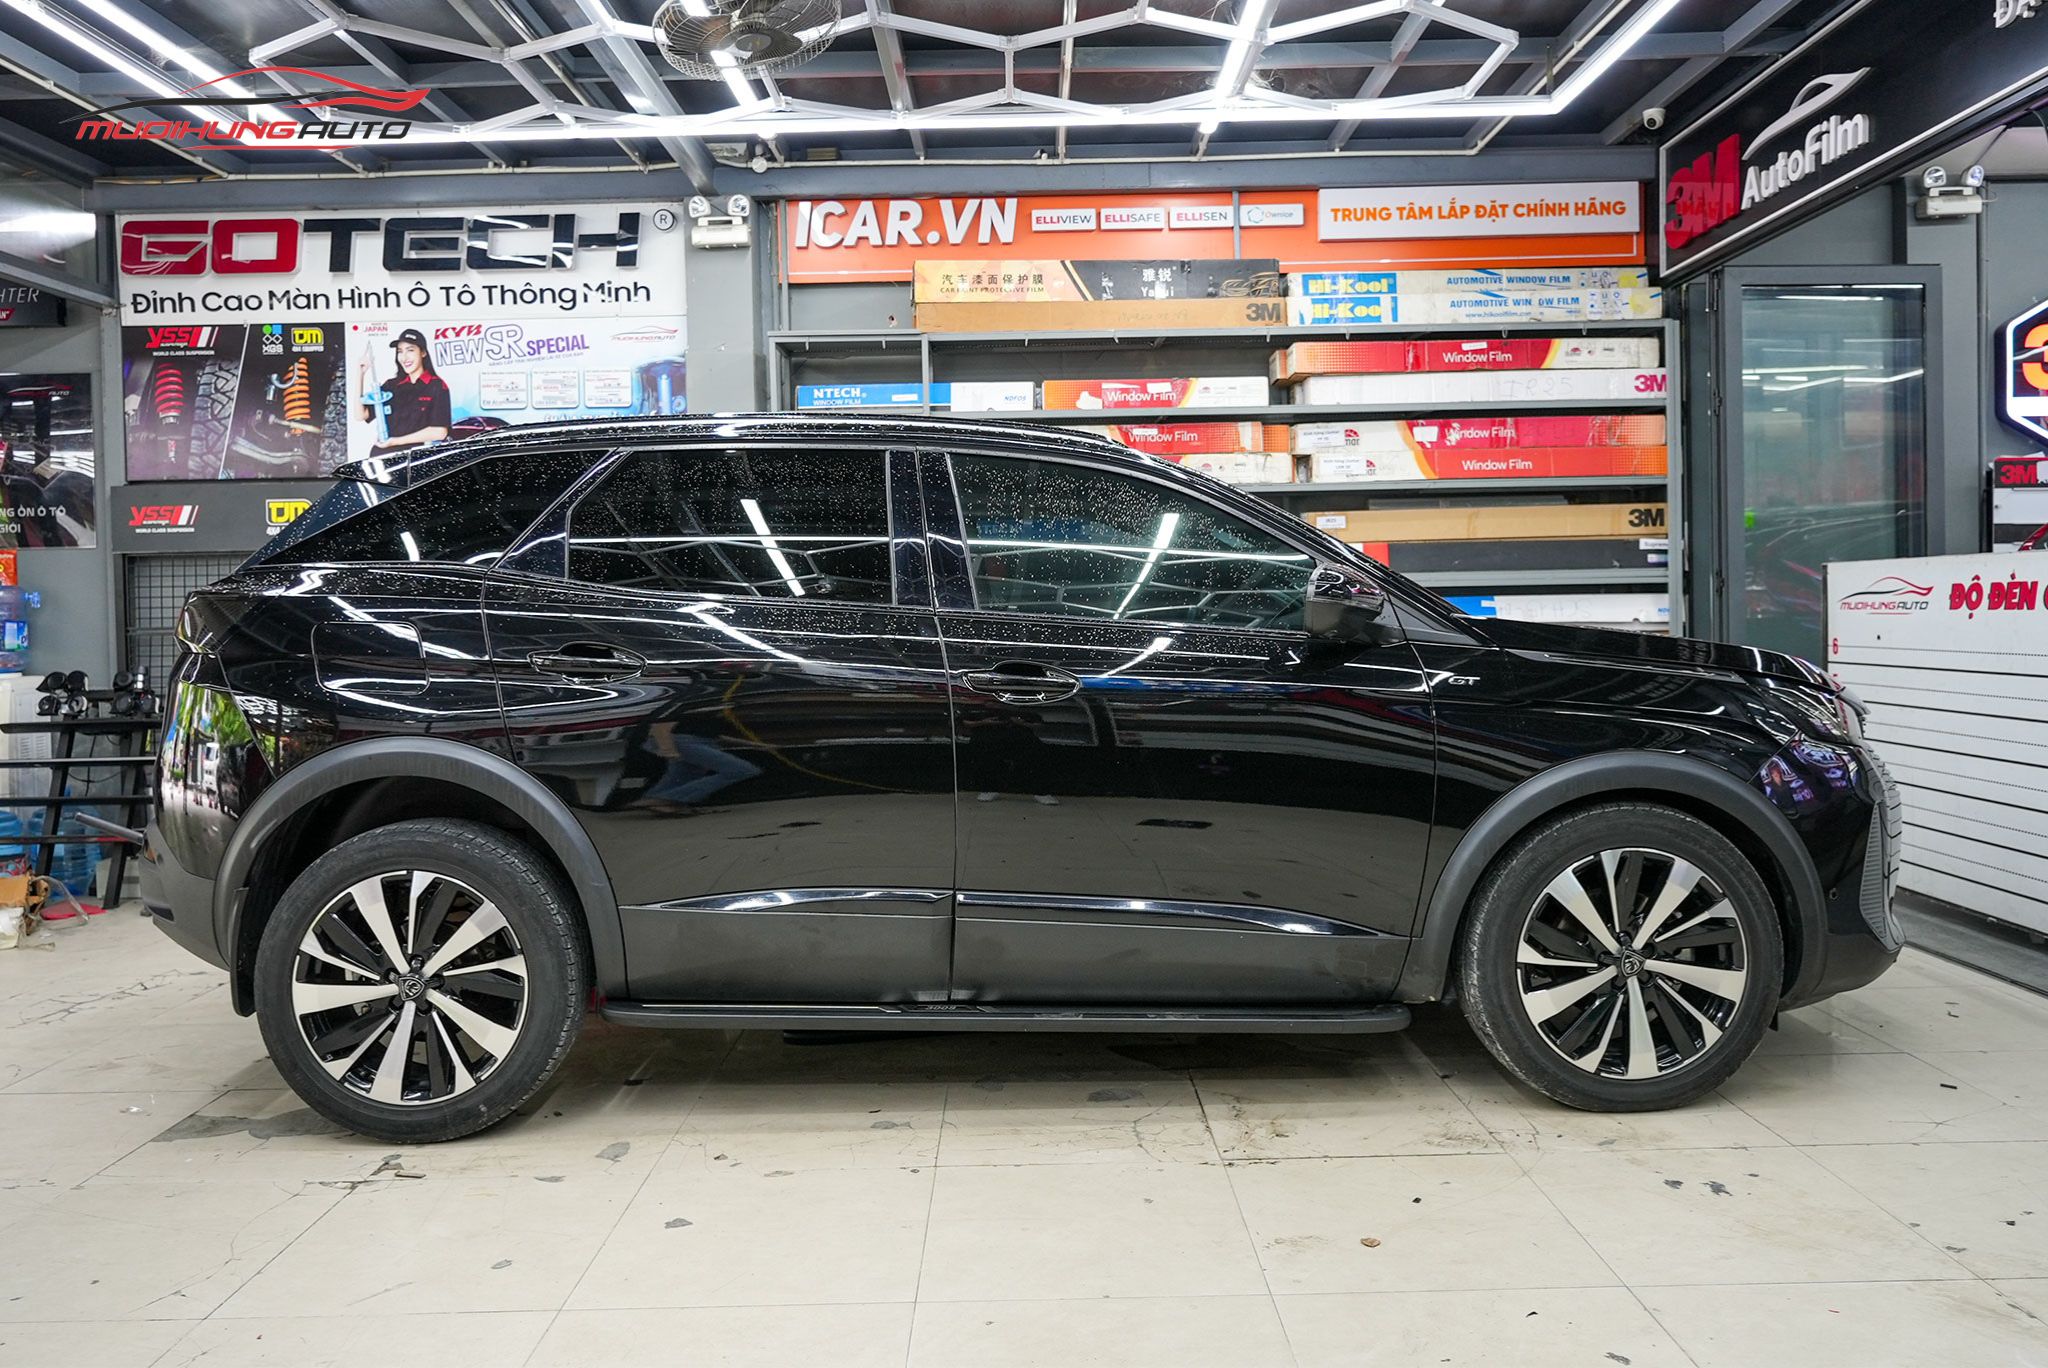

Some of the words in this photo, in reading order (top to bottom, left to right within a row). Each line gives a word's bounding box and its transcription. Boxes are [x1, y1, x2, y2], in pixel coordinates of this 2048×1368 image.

[1665, 134, 1741, 249] 3M
[1741, 113, 1870, 210] AutoFilm
[1176, 211, 1228, 222] ELLISEN
[1331, 206, 1392, 222] TRUNG
[1397, 202, 1432, 220] TÂM
[1438, 198, 1470, 219] LẮP
[1475, 200, 1507, 222] ĐẶT
[1513, 199, 1570, 218] CHÍNH
[1574, 198, 1626, 216] HÃNG
[795, 199, 1018, 248] ICAR.VN
[1035, 214, 1092, 225] ELLIVIEW
[1104, 213, 1161, 223] ELLISAFE
[120, 212, 641, 276] GOTECH
[942, 274, 1044, 285] 汽车漆面保护膜
[1142, 268, 1173, 282] 雅锐
[1446, 276, 1503, 285] AUTOMOTIVE
[1506, 275, 1547, 284] WINDOW
[1549, 275, 1571, 284] FILM
[131, 290, 196, 314] Đỉnh
[201, 292, 263, 312] Cao
[268, 288, 330, 311] Màn
[338, 286, 400, 310] Hình
[408, 281, 430, 307] Ô
[440, 284, 476, 307] Tô
[483, 282, 577, 310] Thông
[584, 281, 651, 304] Minh
[1450, 299, 1509, 308] AUTOMOTIVE
[1512, 298, 1554, 307] WINOW
[1557, 297, 1580, 306] FILM
[1246, 303, 1281, 322] 3M
[435, 325, 482, 340] KYB
[435, 338, 484, 367] NEW
[485, 323, 528, 362] SR
[527, 334, 590, 357] SPECIAL
[1443, 352, 1487, 364] Window
[1489, 350, 1512, 362] Film
[1634, 374, 1667, 393] 3M
[813, 388, 861, 399] NTECH
[1107, 391, 1151, 401] Window
[1153, 392, 1176, 401] Film
[1129, 431, 1172, 442] Window
[1175, 431, 1198, 442] Film
[1491, 426, 1515, 438] Film
[1462, 460, 1507, 471] Window
[1509, 459, 1532, 470] Film
[2000, 464, 2037, 486] 3M
[1628, 508, 1665, 528] 3M
[1950, 575, 1984, 619] ĐỘ
[1988, 570, 2039, 611] ĐÈN
[1832, 638, 1839, 655] 6
[1448, 676, 1480, 686] GT
